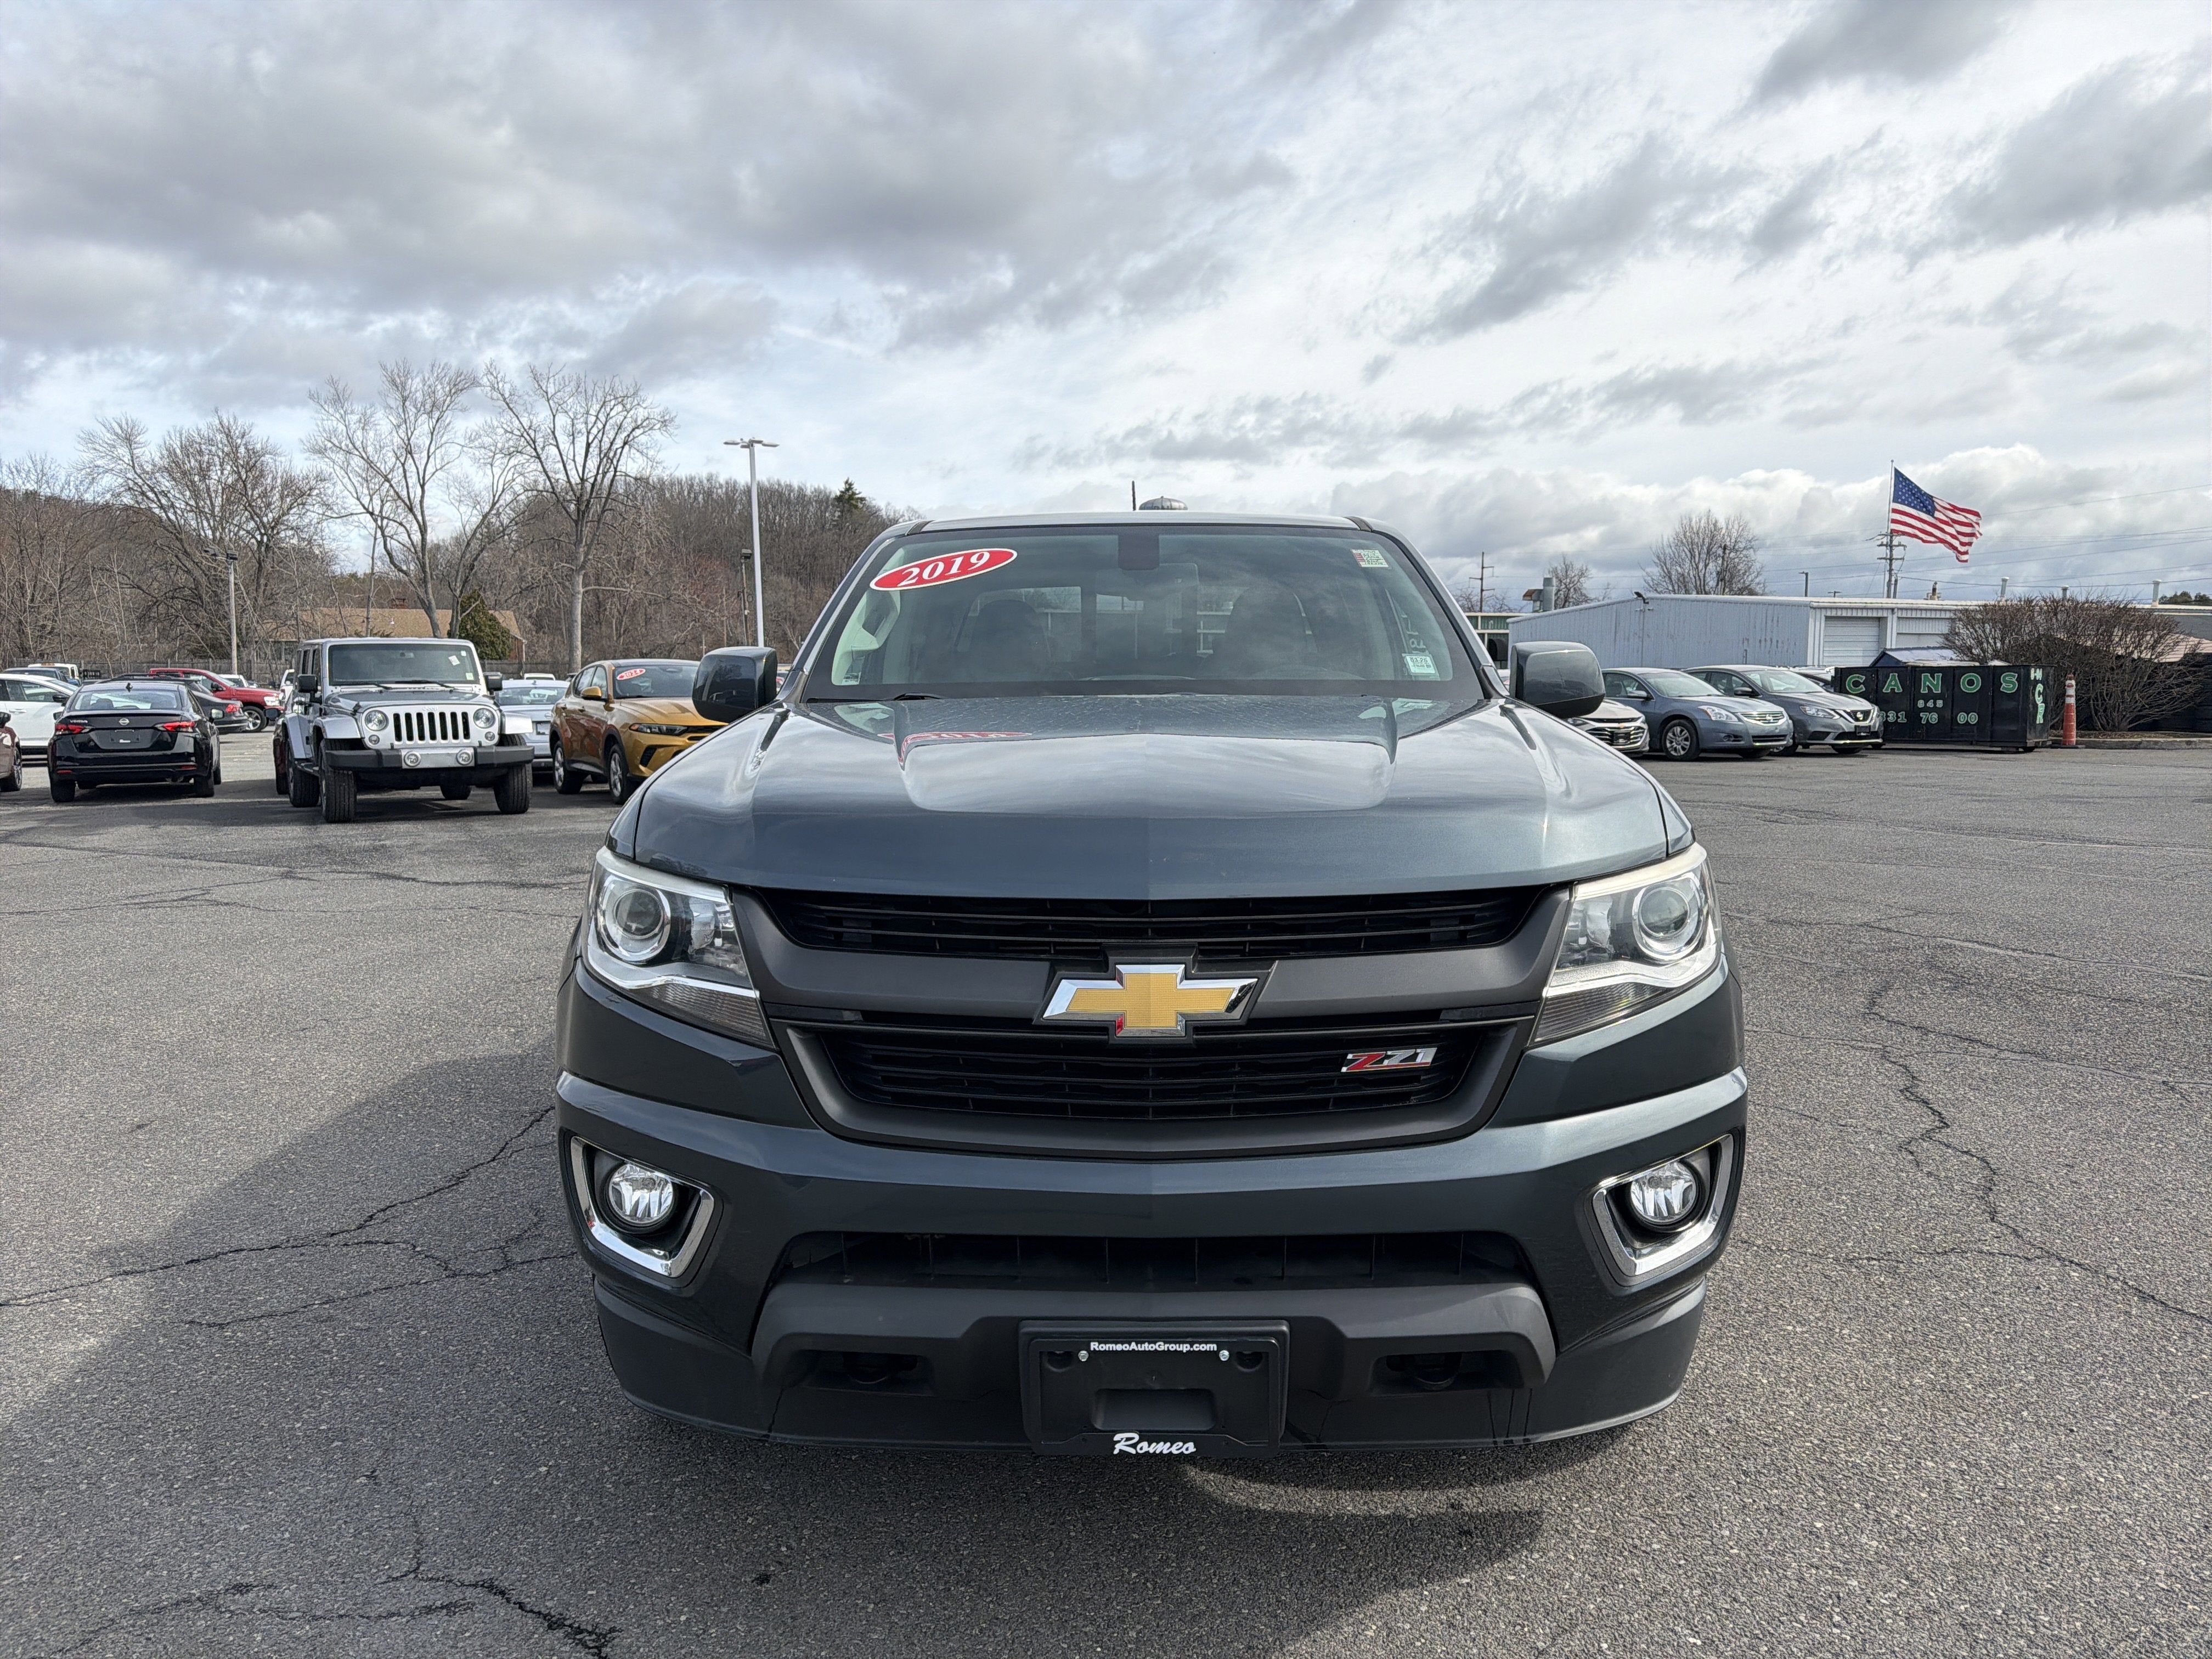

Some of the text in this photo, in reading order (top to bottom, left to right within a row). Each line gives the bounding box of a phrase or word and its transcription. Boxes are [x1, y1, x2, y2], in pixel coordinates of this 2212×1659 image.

[897, 551, 990, 586] 2019
[1846, 673, 2018, 693] CANOS
[1917, 699, 1943, 708] 845
[1920, 713, 1938, 724] 76
[1957, 713, 1978, 724] 00
[1341, 1047, 1437, 1072] Z71
[1090, 1342, 1217, 1352] RomeoAutoGroup.com
[1113, 1432, 1197, 1454] Romeo
